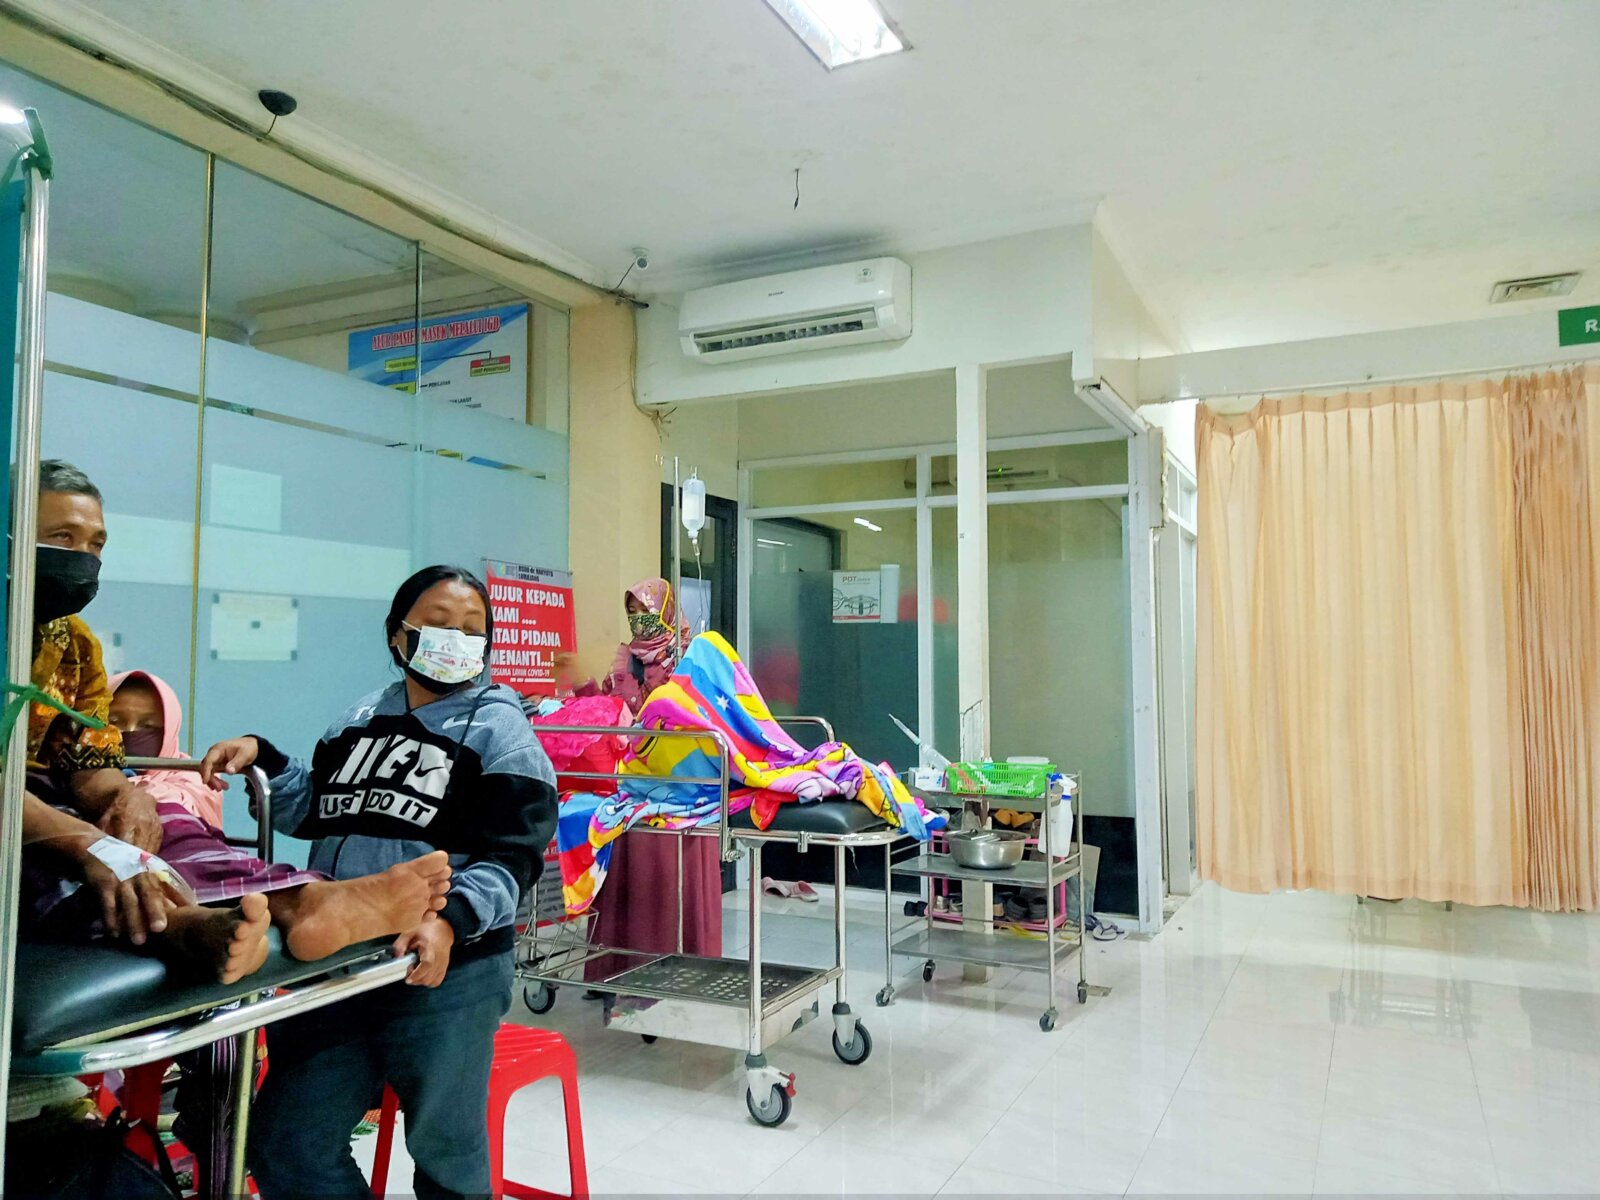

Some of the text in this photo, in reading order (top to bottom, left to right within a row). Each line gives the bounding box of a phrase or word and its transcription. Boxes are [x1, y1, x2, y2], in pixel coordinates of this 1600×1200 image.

[392, 328, 416, 348] PASIE
[489, 584, 565, 608] JUJUR KEPADA
[521, 629, 561, 647] PIDANA
[366, 791, 395, 811] DO
[399, 799, 431, 822] IT
